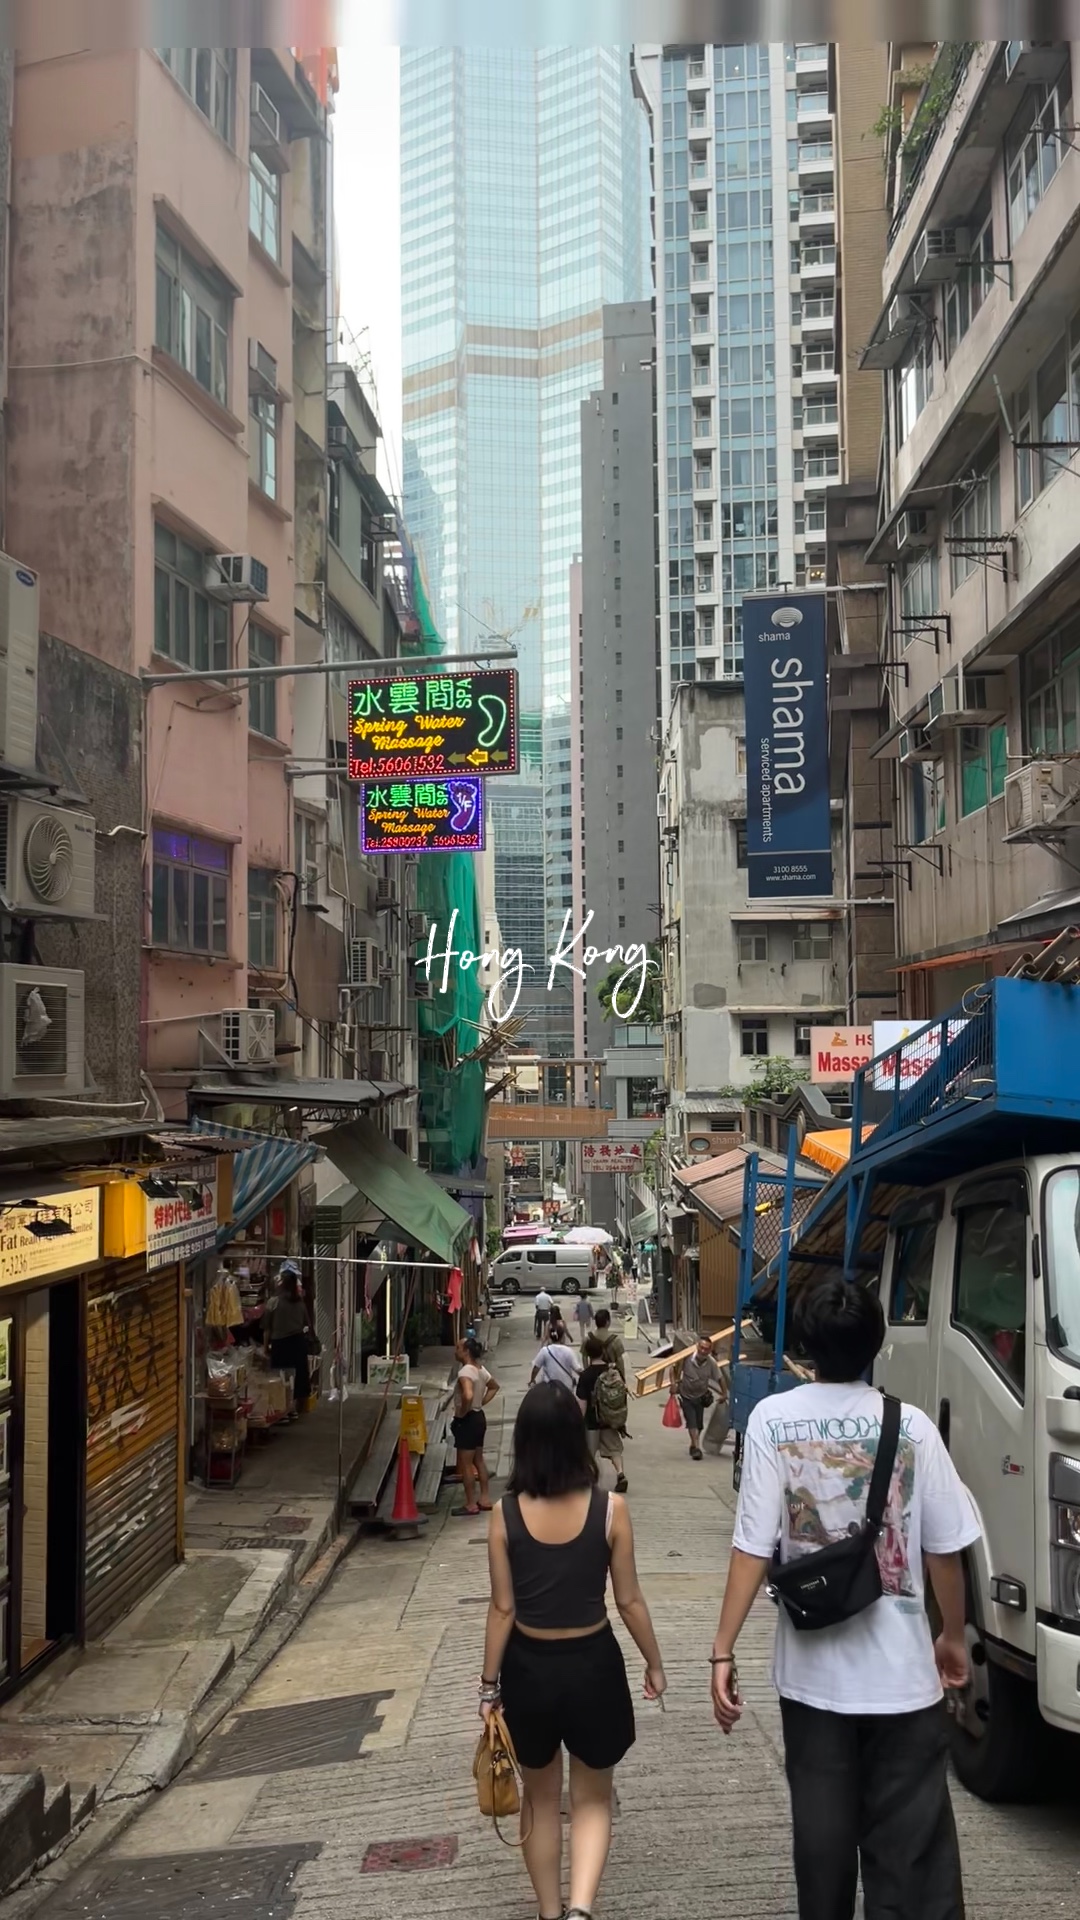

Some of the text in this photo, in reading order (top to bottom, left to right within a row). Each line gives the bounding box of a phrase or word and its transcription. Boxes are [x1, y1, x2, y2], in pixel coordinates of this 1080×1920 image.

[758, 631, 791, 642] shama
[353, 679, 454, 716] 水雲間
[456, 678, 472, 709] SPA
[353, 714, 467, 740] Spring Water
[770, 657, 814, 795] shama
[371, 735, 445, 753] Massage
[366, 783, 436, 808] 水雲間
[436, 783, 449, 805] SPA
[760, 737, 773, 843] serviced apartments
[456, 792, 473, 812] 1/F
[368, 807, 451, 824] Spring Water
[381, 822, 436, 837] Massage
[765, 873, 817, 881] www.shama.com
[773, 864, 808, 874] 3100 8555
[711, 1135, 741, 1145] shama
